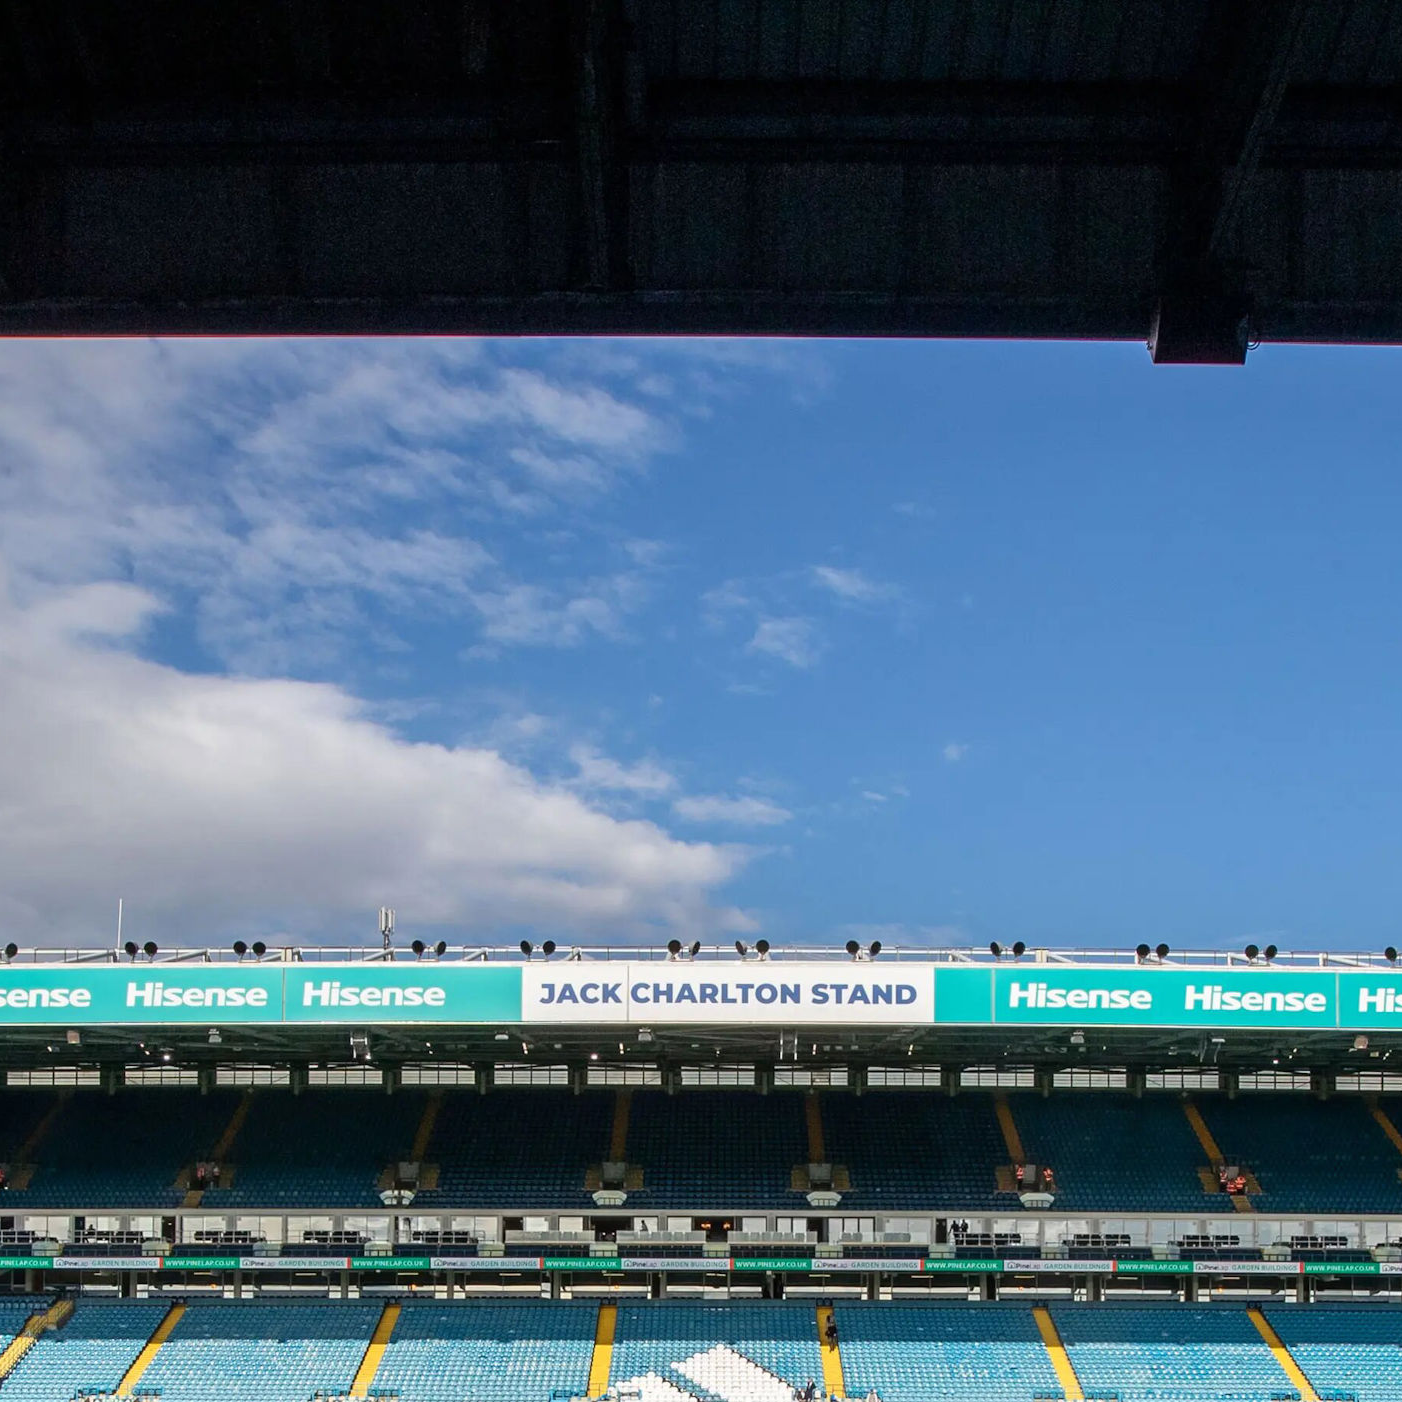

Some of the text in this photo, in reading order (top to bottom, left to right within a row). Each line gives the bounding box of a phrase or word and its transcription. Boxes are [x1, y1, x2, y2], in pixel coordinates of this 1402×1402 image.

[126, 982, 268, 1008] Hisense
[302, 981, 446, 1007] Hisense
[539, 982, 918, 1005] JACK CHARLTON STAND
[1008, 982, 1153, 1009] Hisense
[1184, 985, 1327, 1013] Hisense
[91, 1259, 119, 1267] GARDEN
[121, 1259, 158, 1267] BUILDINGS
[278, 1260, 344, 1268] GARDEN BUILDINGS
[471, 1260, 499, 1268] GARDEN
[501, 1260, 537, 1268] BUILDINGS
[661, 1261, 689, 1269] GARDEN
[691, 1261, 728, 1269] BUILDINGS
